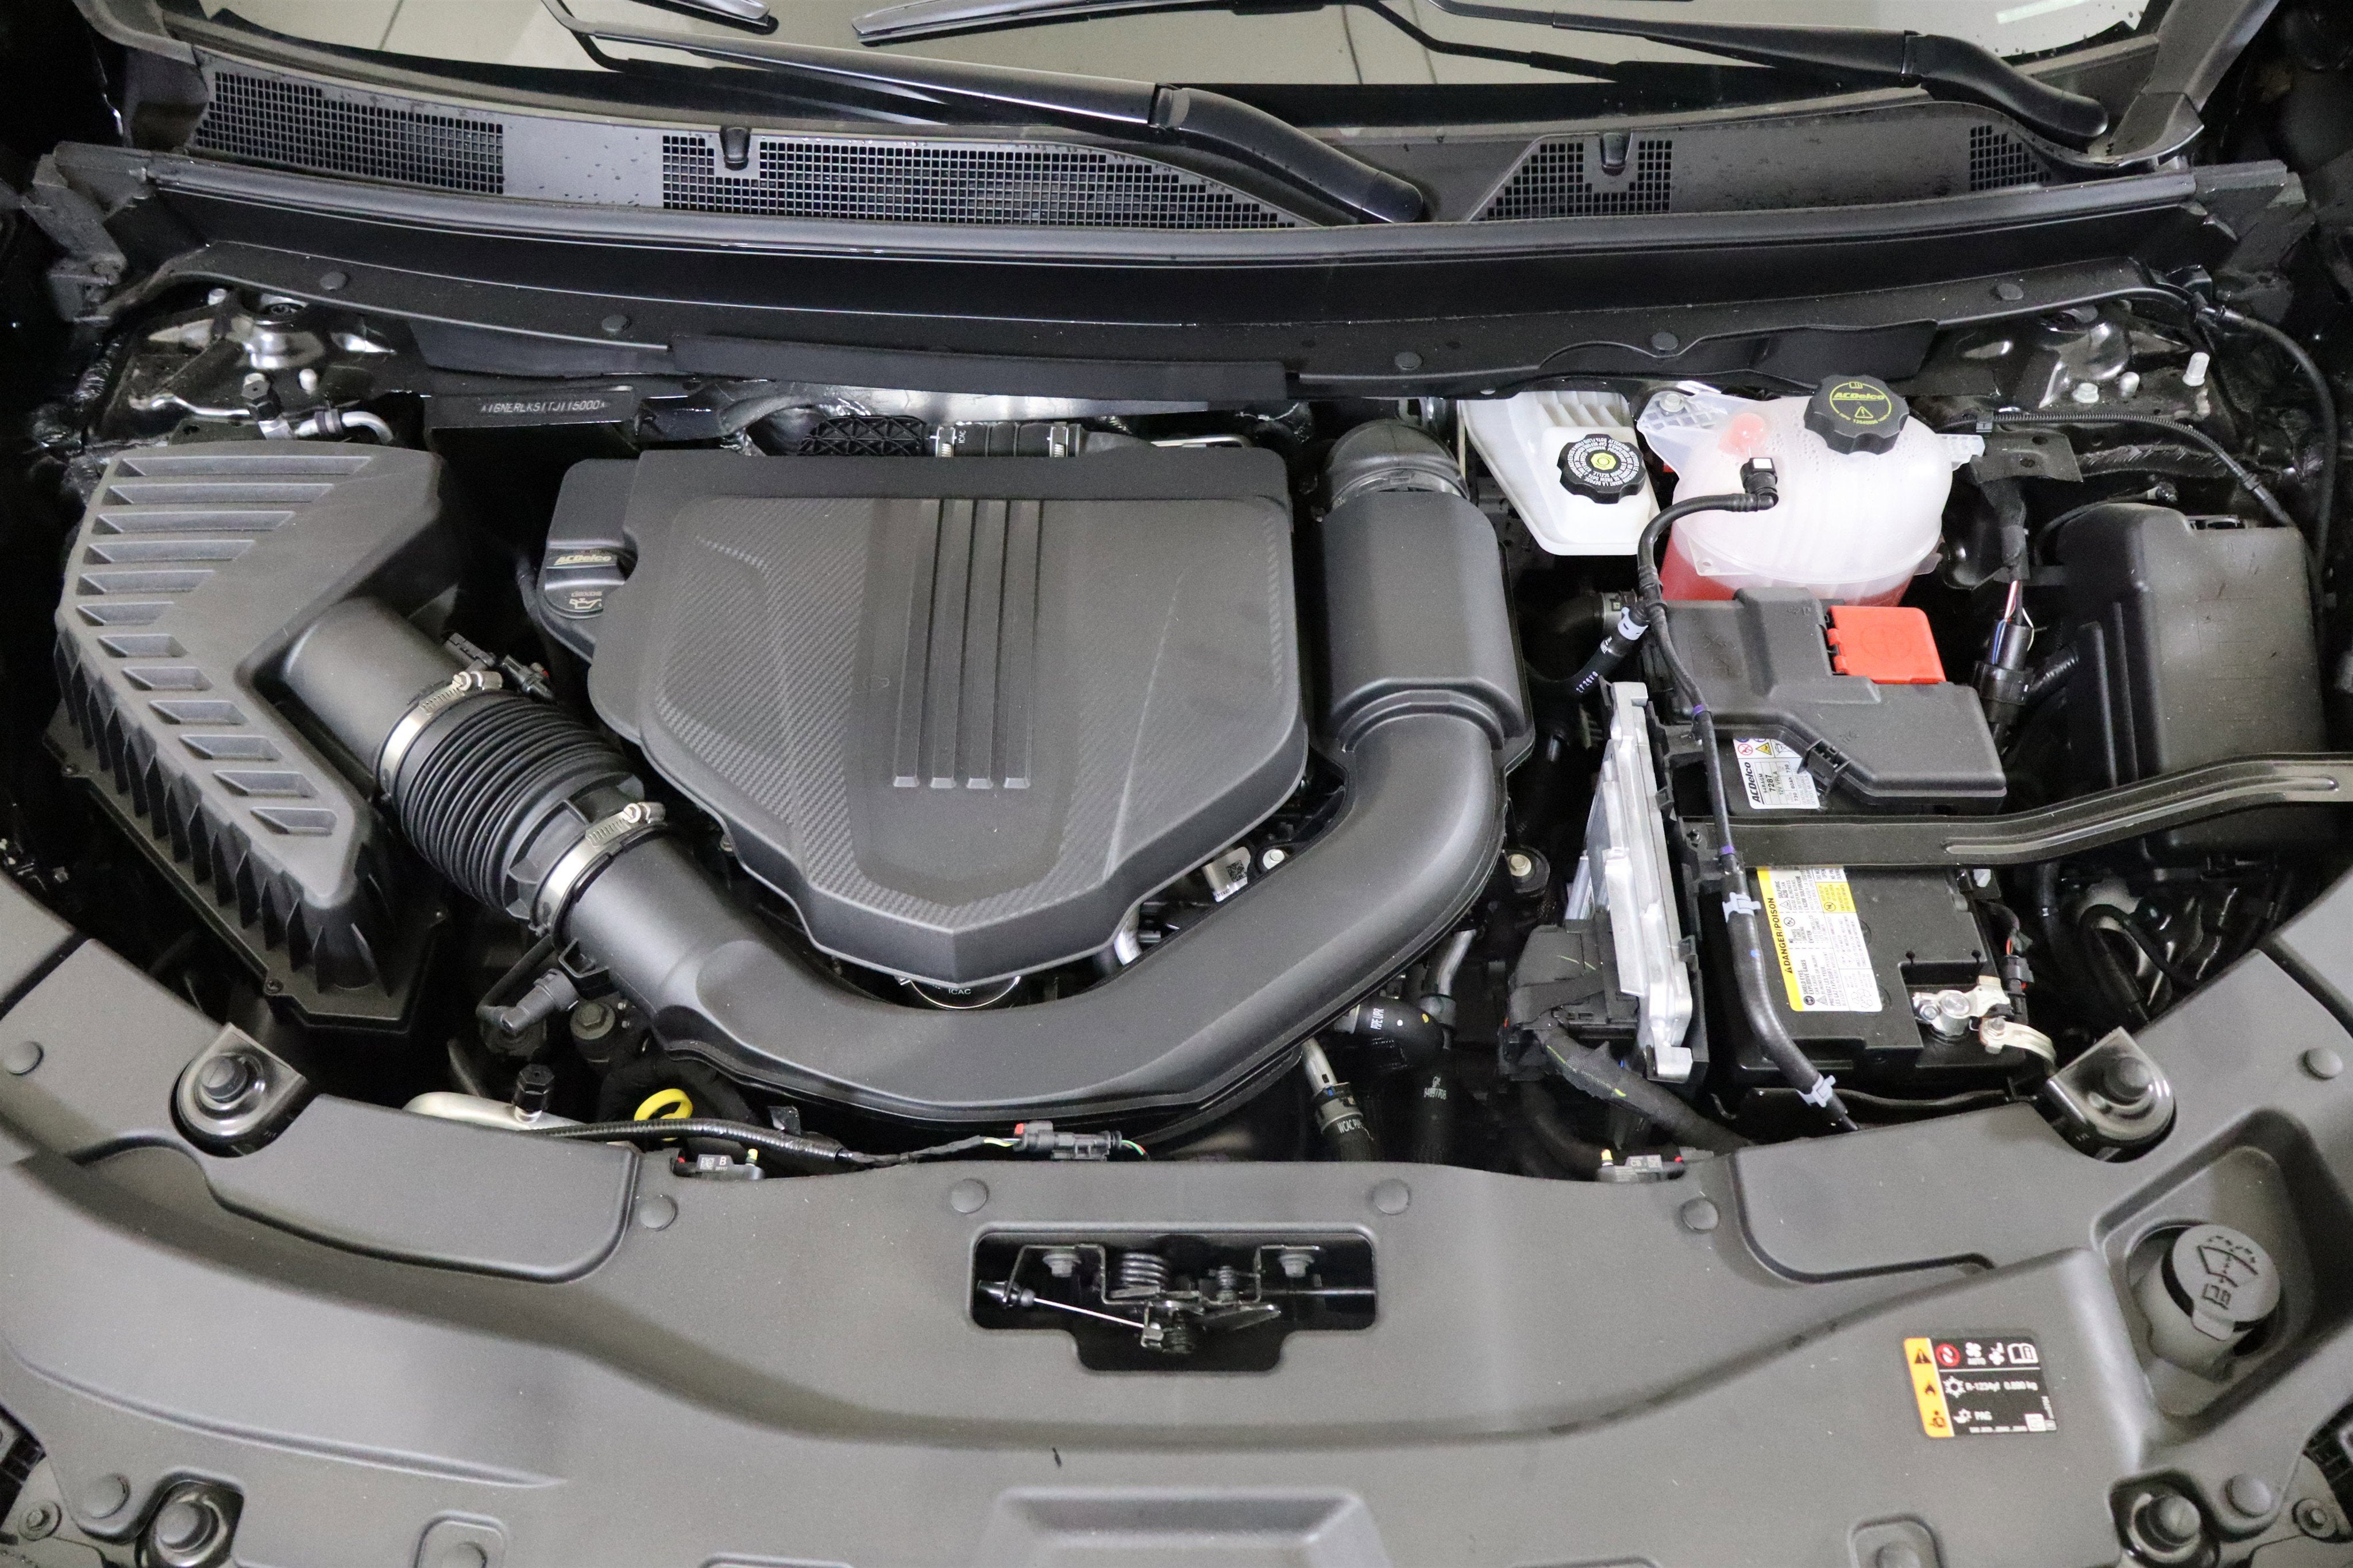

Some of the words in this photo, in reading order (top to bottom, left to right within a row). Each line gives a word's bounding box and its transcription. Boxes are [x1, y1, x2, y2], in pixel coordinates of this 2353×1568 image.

[1833, 392, 1885, 400] ACDelco
[1743, 762, 1761, 802] ACDelco
[1766, 775, 1776, 791] 7287
[1775, 881, 1783, 898] SULFURIC
[1767, 898, 1791, 965] DANGER/POISON
[1804, 974, 1814, 994] EXPLOSIVE
[1373, 1008, 1384, 1019] UPR
[1371, 1018, 1383, 1030] PIPE
[1337, 1119, 1355, 1134] WCAC
[719, 1156, 727, 1166] B
